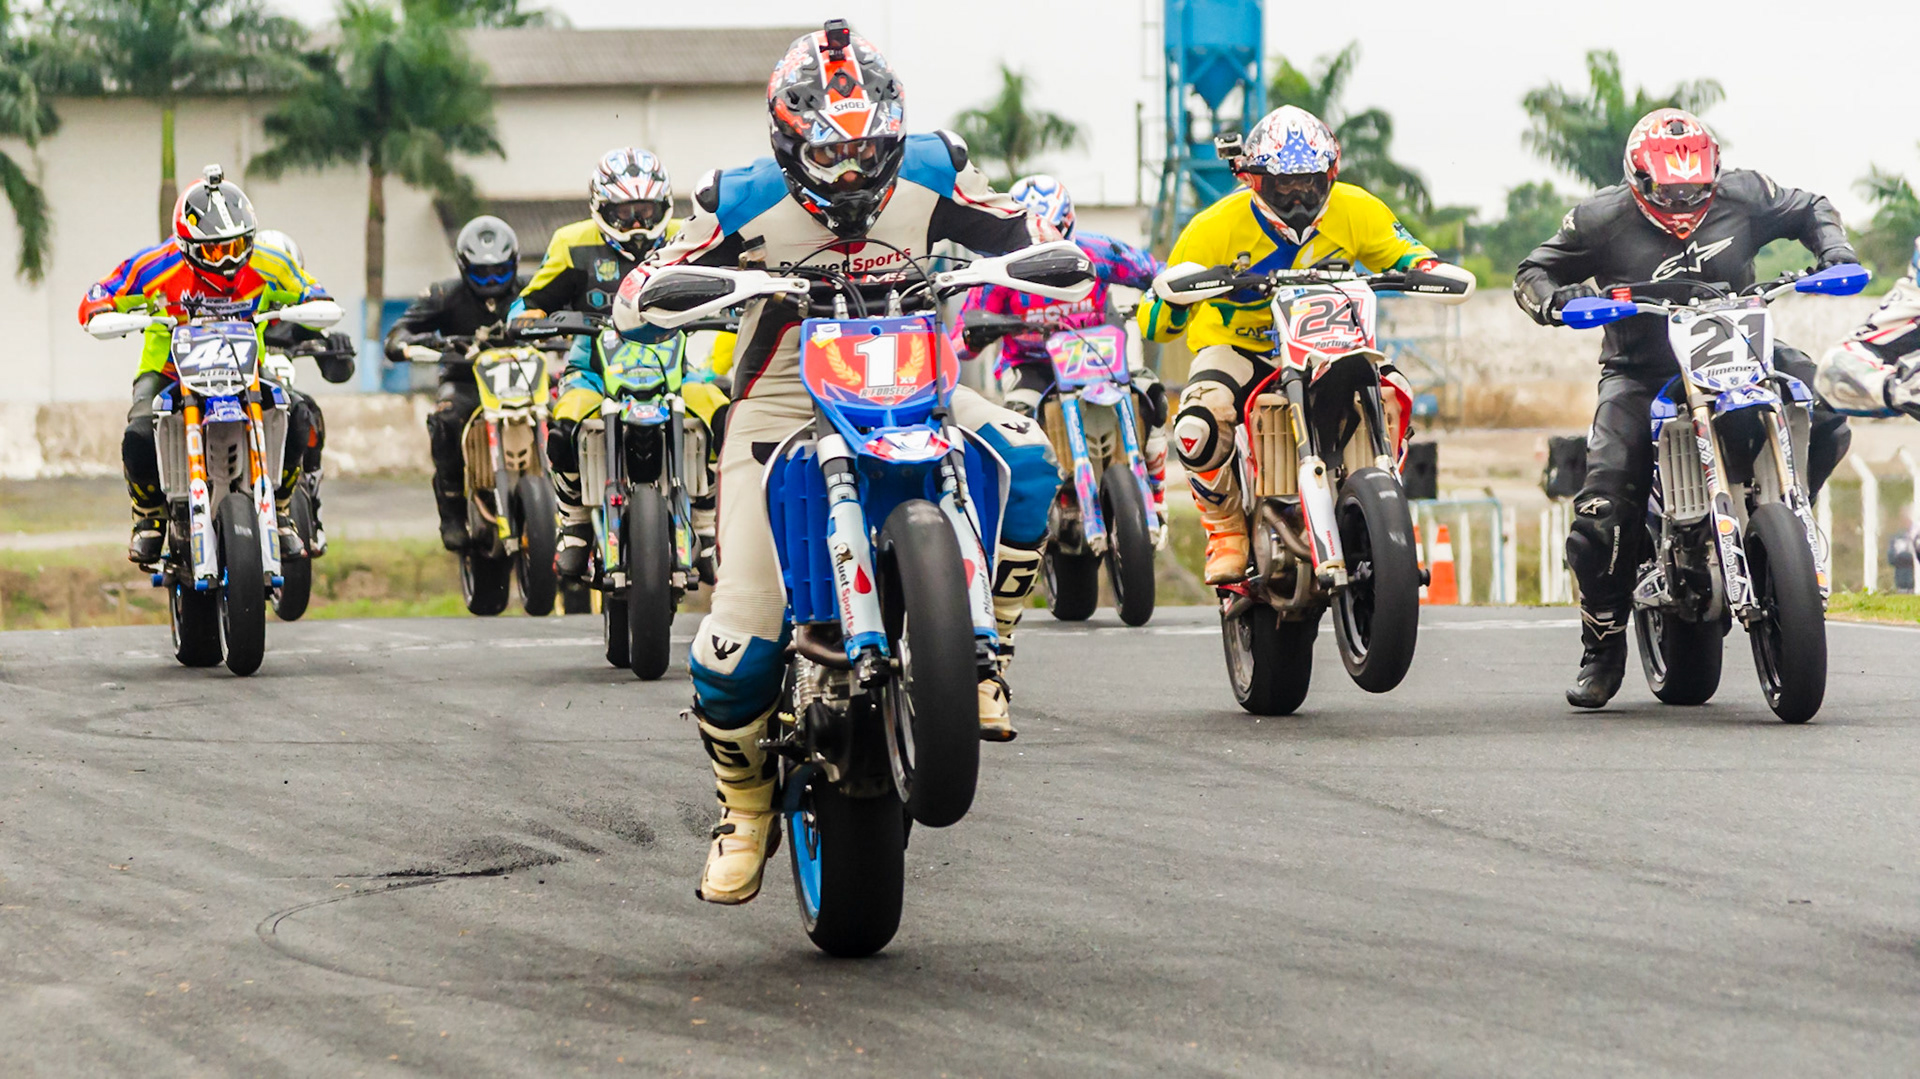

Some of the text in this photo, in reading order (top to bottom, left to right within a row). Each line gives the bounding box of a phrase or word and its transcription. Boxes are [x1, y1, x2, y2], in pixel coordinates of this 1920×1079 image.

[834, 101, 865, 112] SHOEI
[852, 248, 911, 272] Sports
[1026, 298, 1095, 323] MOTUL
[1298, 299, 1360, 338] 24
[180, 339, 252, 369] 44
[611, 340, 676, 369] 46
[1061, 336, 1117, 377] 75
[1690, 313, 1765, 372] 21
[855, 334, 898, 388] 1
[1706, 365, 1759, 377] Jimenez
[485, 361, 538, 393] 17
[1325, 530, 1336, 557] HONDA
[1722, 535, 1742, 601] Posto Basilio
[841, 588, 855, 629] Sports
